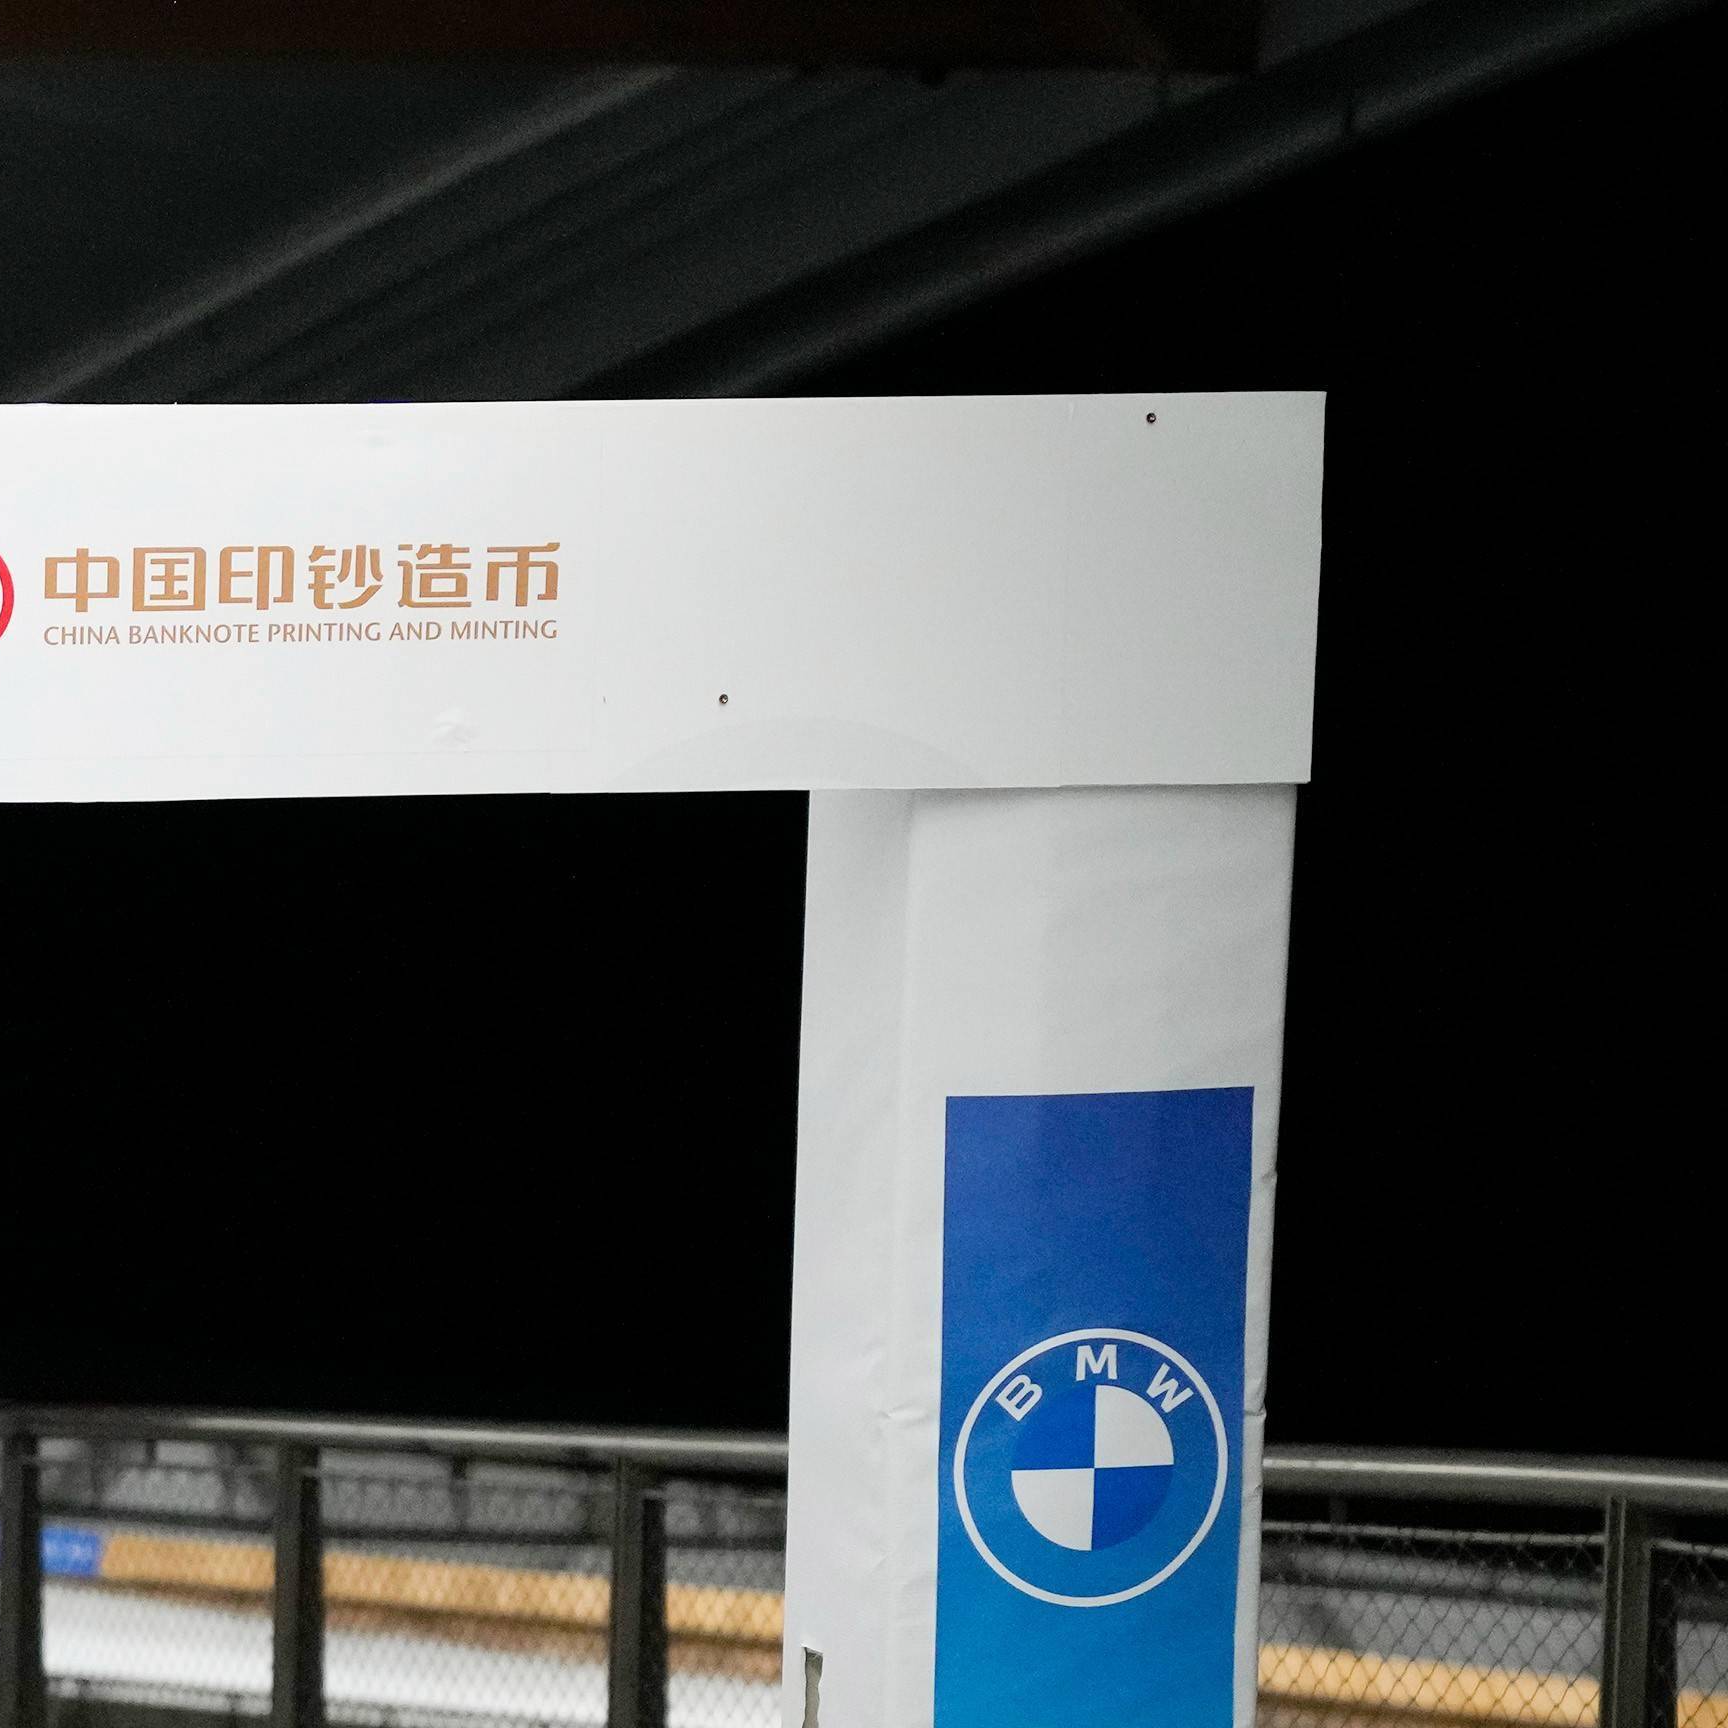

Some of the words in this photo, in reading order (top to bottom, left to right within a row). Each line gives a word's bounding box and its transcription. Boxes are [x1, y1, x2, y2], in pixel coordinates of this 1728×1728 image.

[44, 542, 560, 612] 中国印钞造币
[44, 624, 121, 646] CHINA
[128, 622, 260, 645] BANKNOTE
[267, 621, 382, 643] PRINTING
[389, 620, 442, 641] AND
[450, 619, 558, 641] MINTING
[994, 1343, 1195, 1422] BMW
